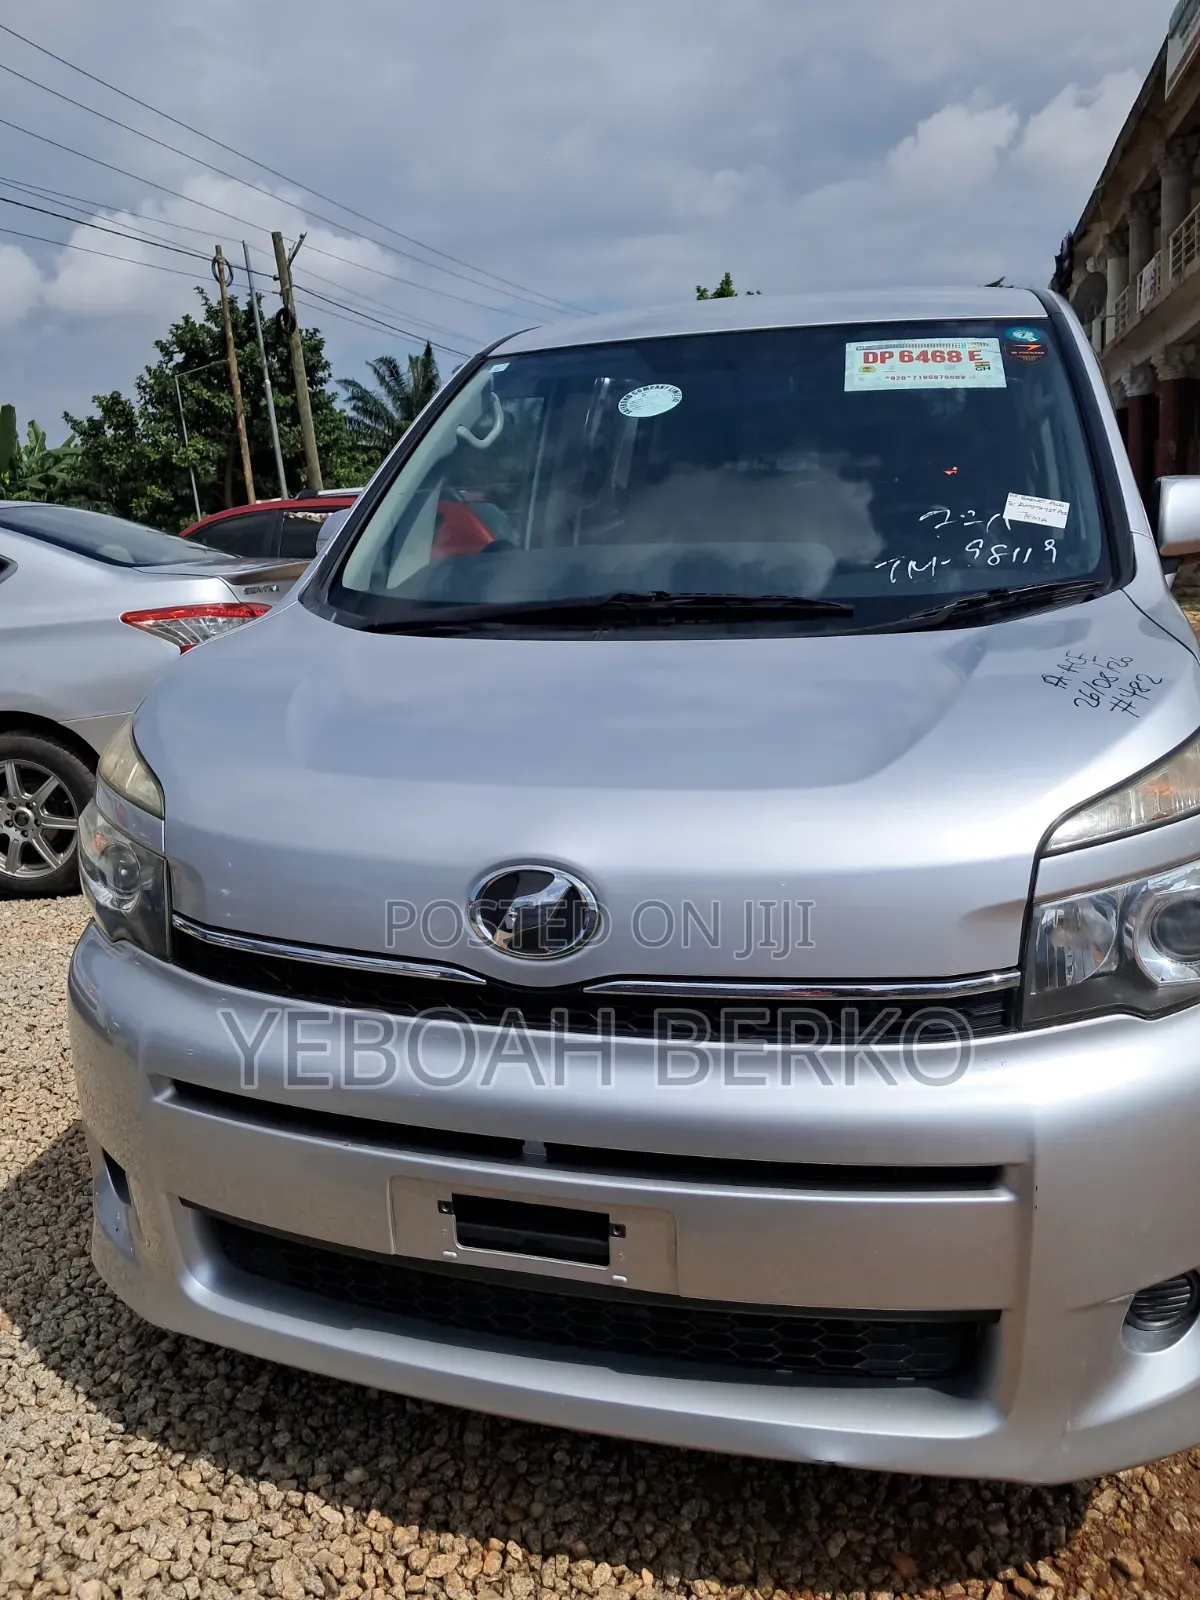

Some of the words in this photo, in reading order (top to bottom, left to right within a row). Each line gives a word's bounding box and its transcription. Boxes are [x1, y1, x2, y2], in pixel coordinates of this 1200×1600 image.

[863, 351, 894, 364] DP
[899, 349, 962, 363] 6468
[968, 349, 983, 361] E
[631, 385, 670, 396] COMPANY
